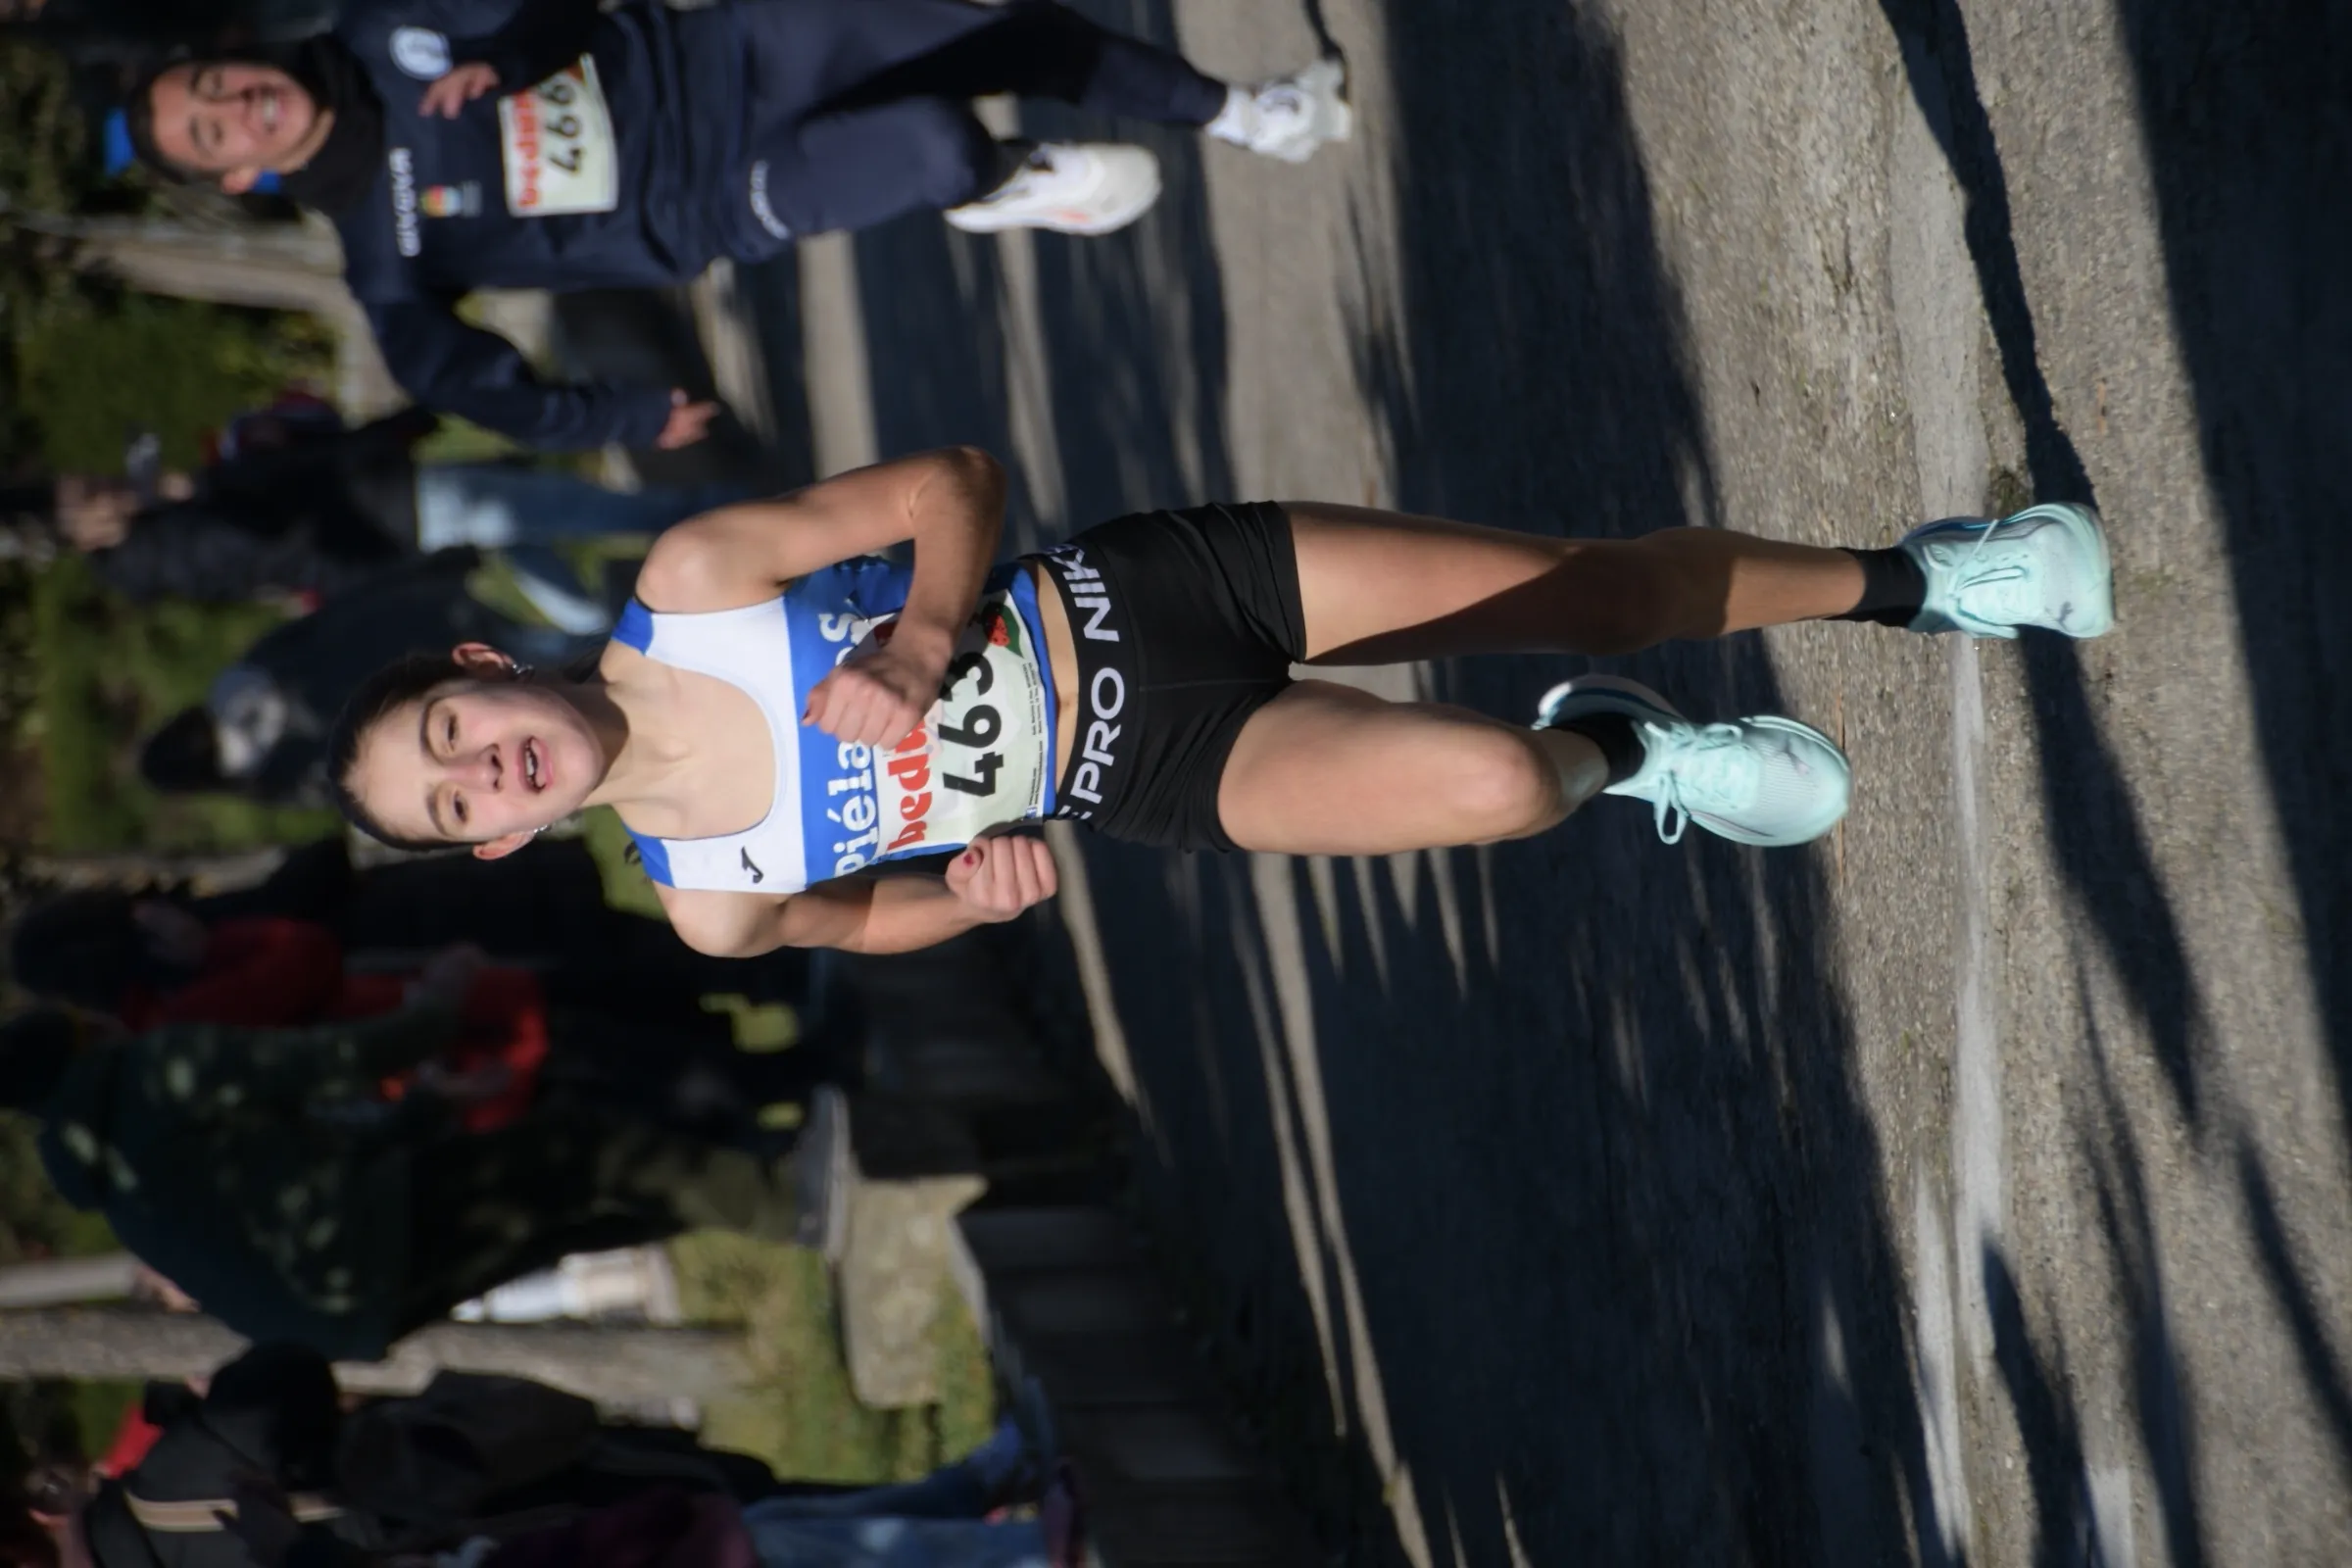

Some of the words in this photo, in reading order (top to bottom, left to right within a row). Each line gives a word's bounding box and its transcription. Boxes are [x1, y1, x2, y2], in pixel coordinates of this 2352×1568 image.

[541, 80, 585, 173] 466
[1050, 549, 1120, 642] NIK
[938, 651, 1004, 797] 463
[1070, 667, 1125, 804] PRO
